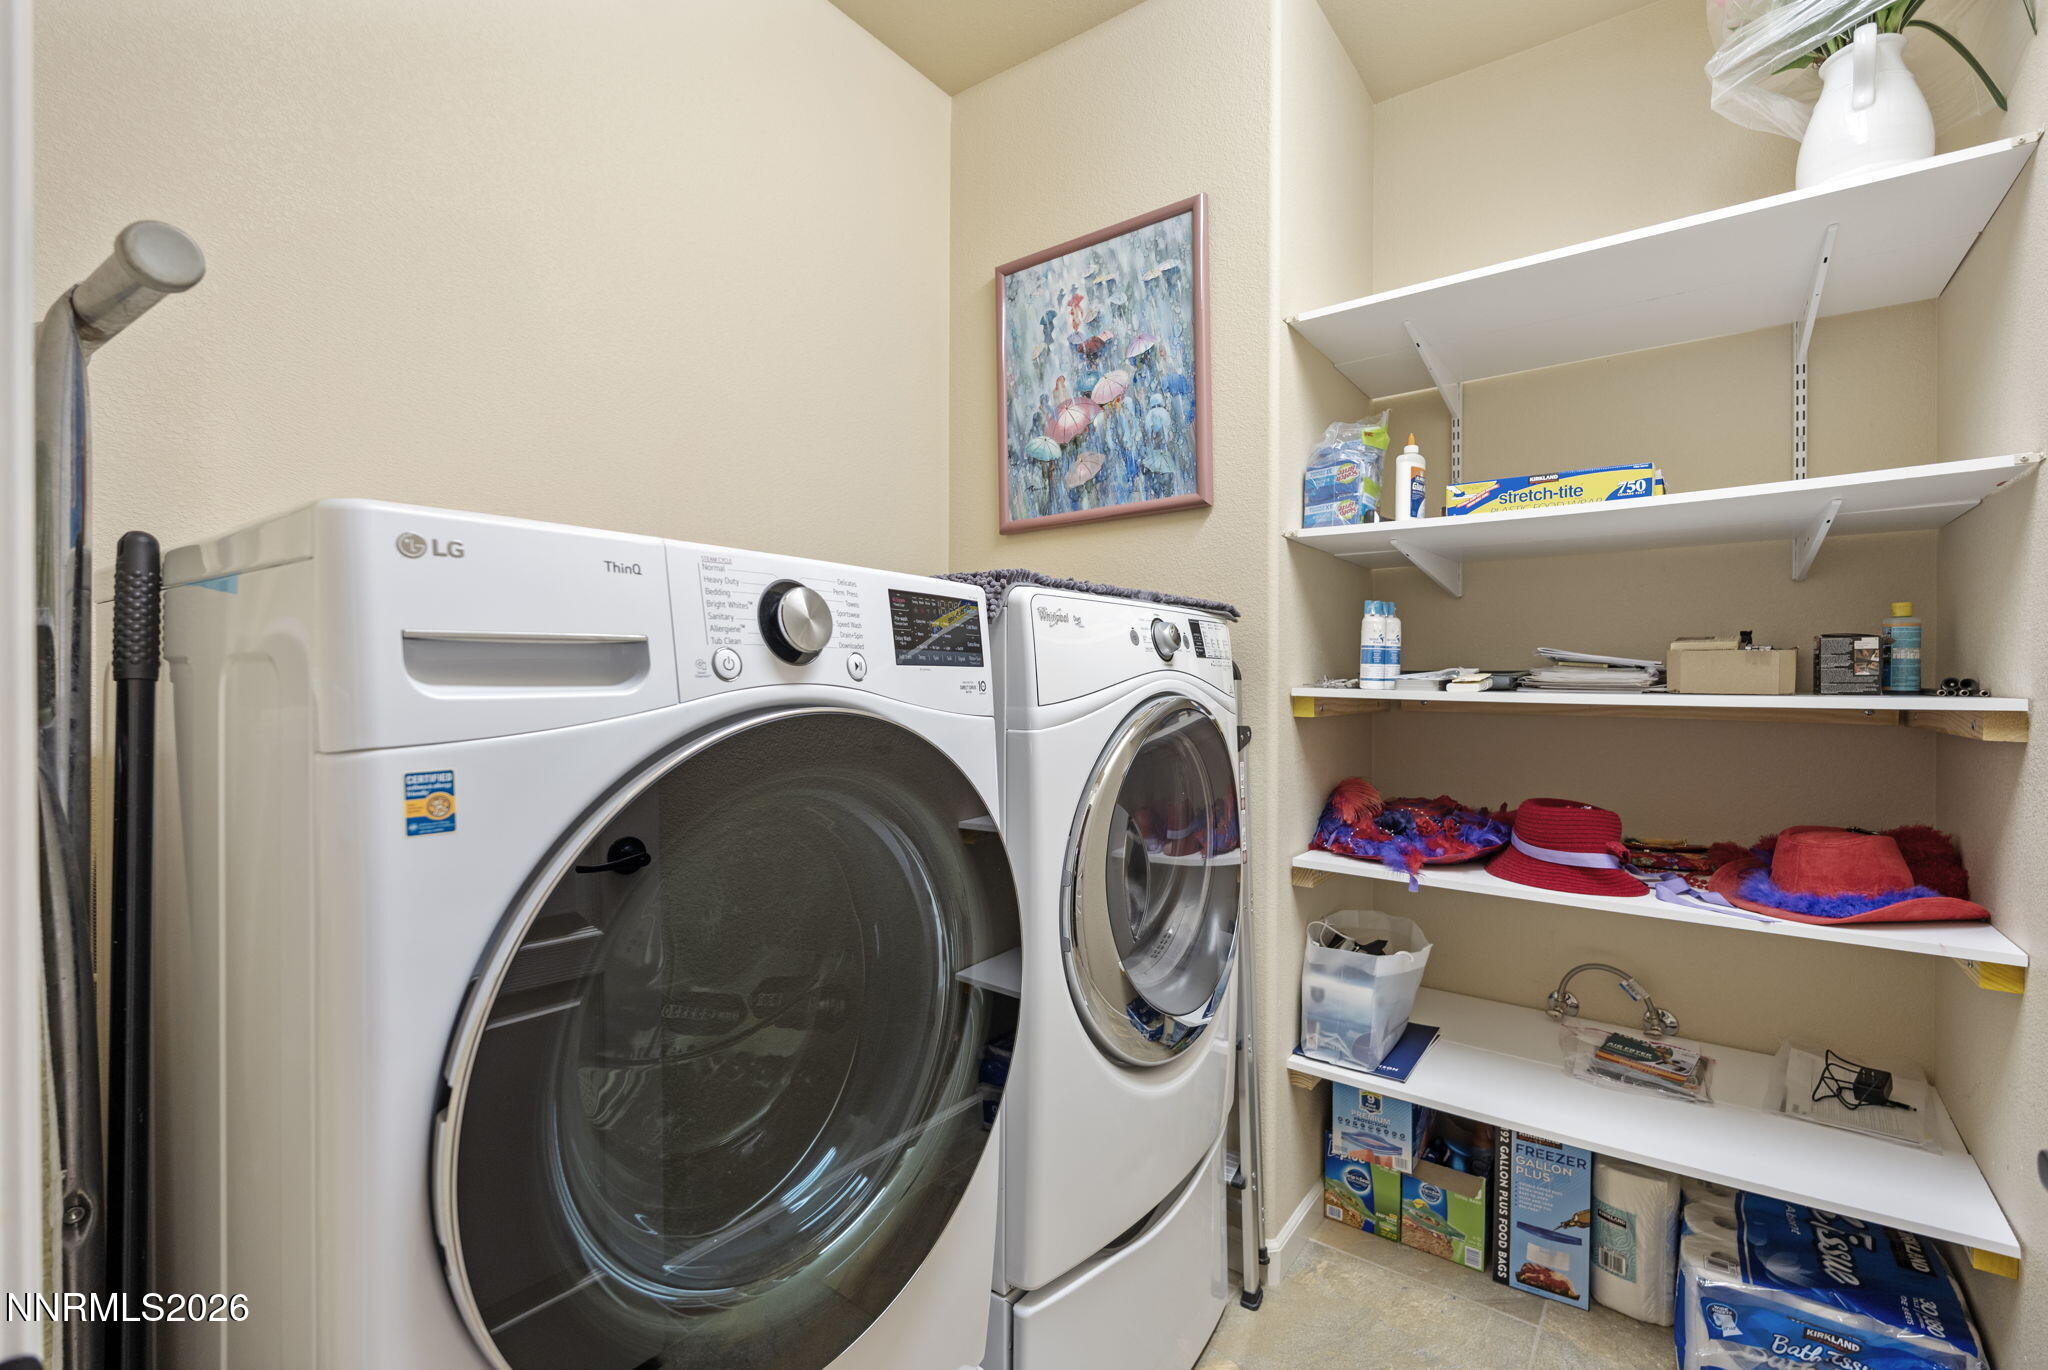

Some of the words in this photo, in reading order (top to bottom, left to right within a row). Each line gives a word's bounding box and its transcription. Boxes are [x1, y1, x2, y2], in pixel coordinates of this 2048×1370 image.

[1529, 474, 1559, 482] KIRKLAND
[1617, 479, 1646, 494] 750
[1498, 485, 1584, 505] stretch-tite
[432, 538, 464, 558] LG
[603, 560, 642, 576] ThinQ
[702, 563, 725, 572] Normal
[703, 576, 723, 585] Heavy
[724, 577, 740, 587] Duty
[704, 587, 731, 598] Bedding
[706, 600, 726, 610] Bright
[707, 611, 734, 623] Sanitary
[711, 636, 723, 645] Tub
[724, 637, 742, 645] Clean
[977, 680, 987, 692] 10
[1366, 1094, 1376, 1104] 9
[1351, 1109, 1391, 1126] PREMIUM
[1515, 1143, 1587, 1170] FREEZER
[1500, 1146, 1510, 1188] GALLON
[1515, 1155, 1572, 1176] GALLON
[1515, 1165, 1551, 1182] PLUS
[1499, 1189, 1509, 1216] PLUS
[1498, 1217, 1508, 1249] FOOD
[1898, 1231, 1930, 1273] IRKLAND
[1497, 1251, 1508, 1279] BAGS
[1772, 1333, 1822, 1362] Bath
[1806, 1328, 1860, 1352] KIRKLAND
